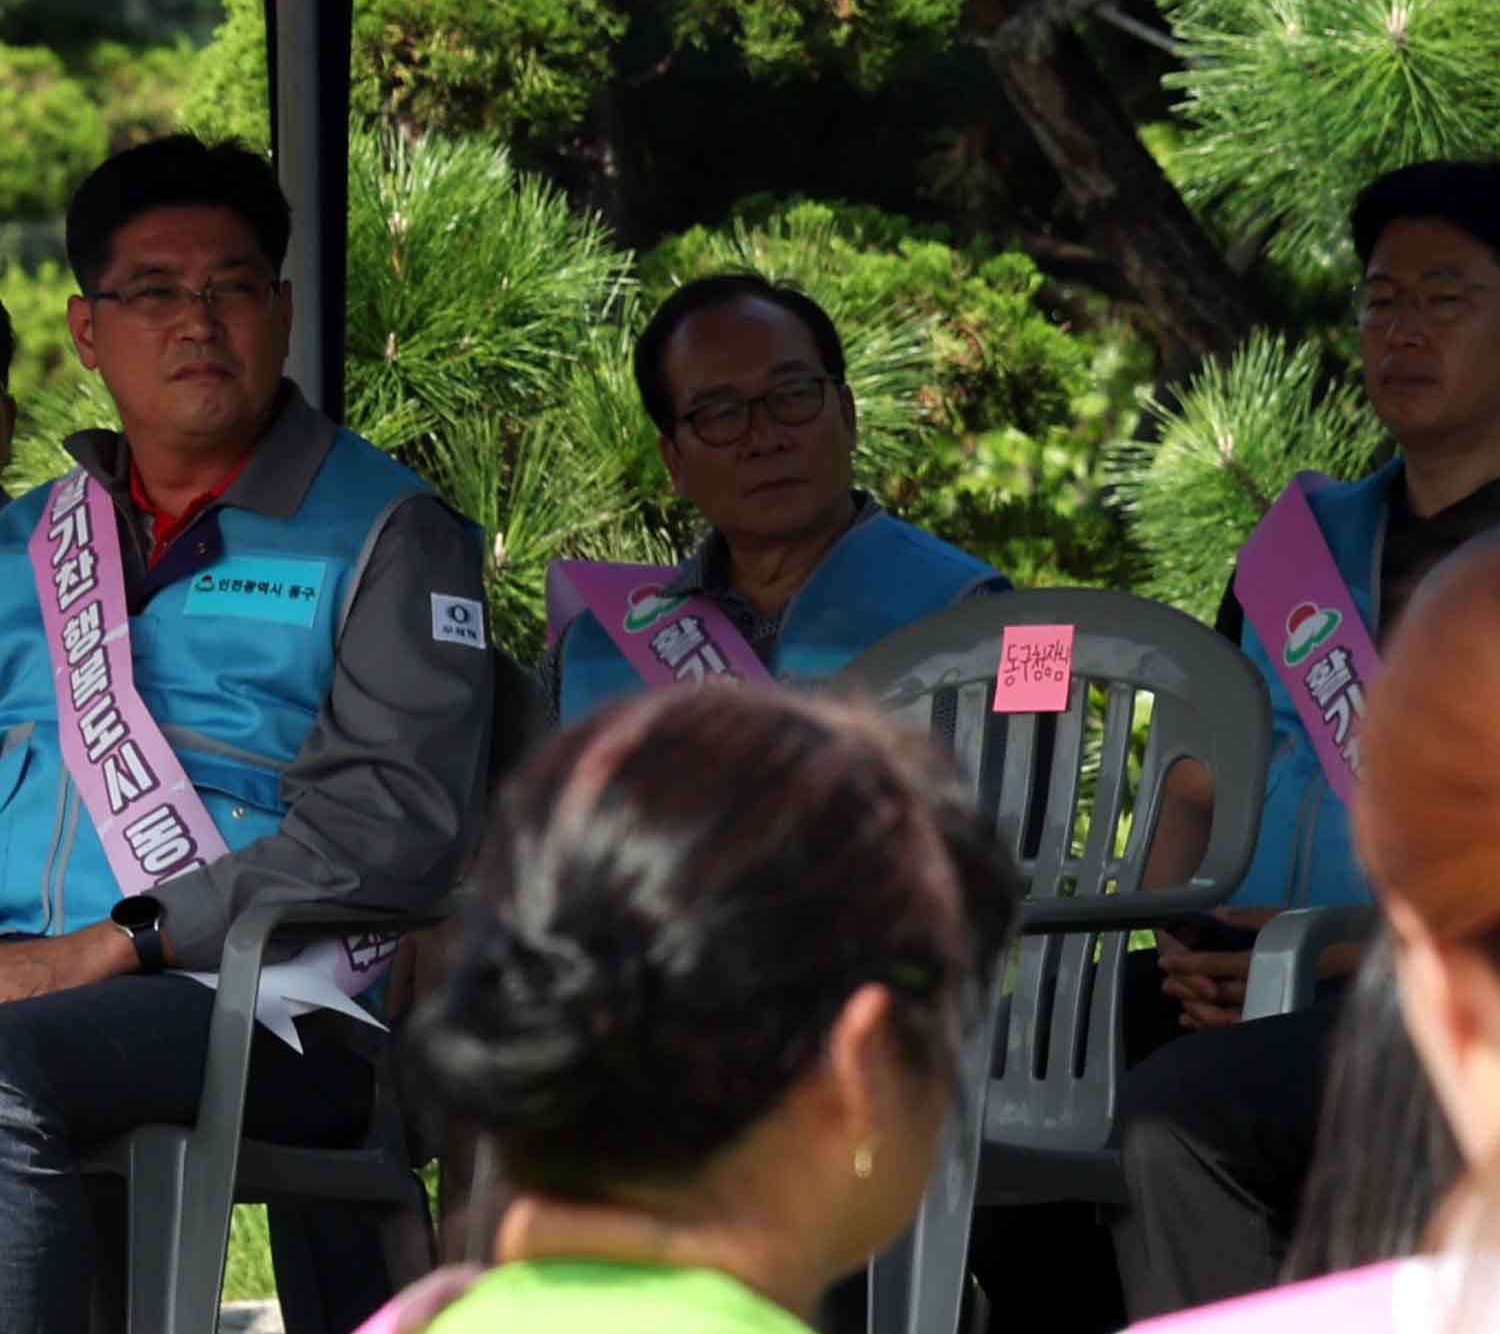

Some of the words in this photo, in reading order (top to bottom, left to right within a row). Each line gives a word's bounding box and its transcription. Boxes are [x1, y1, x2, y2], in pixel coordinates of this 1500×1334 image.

[218, 577, 283, 597] 인천광역시
[288, 584, 317, 601] 동구
[651, 616, 729, 683] 활기
[62, 599, 160, 815] 행복도시
[122, 802, 204, 887] 동
